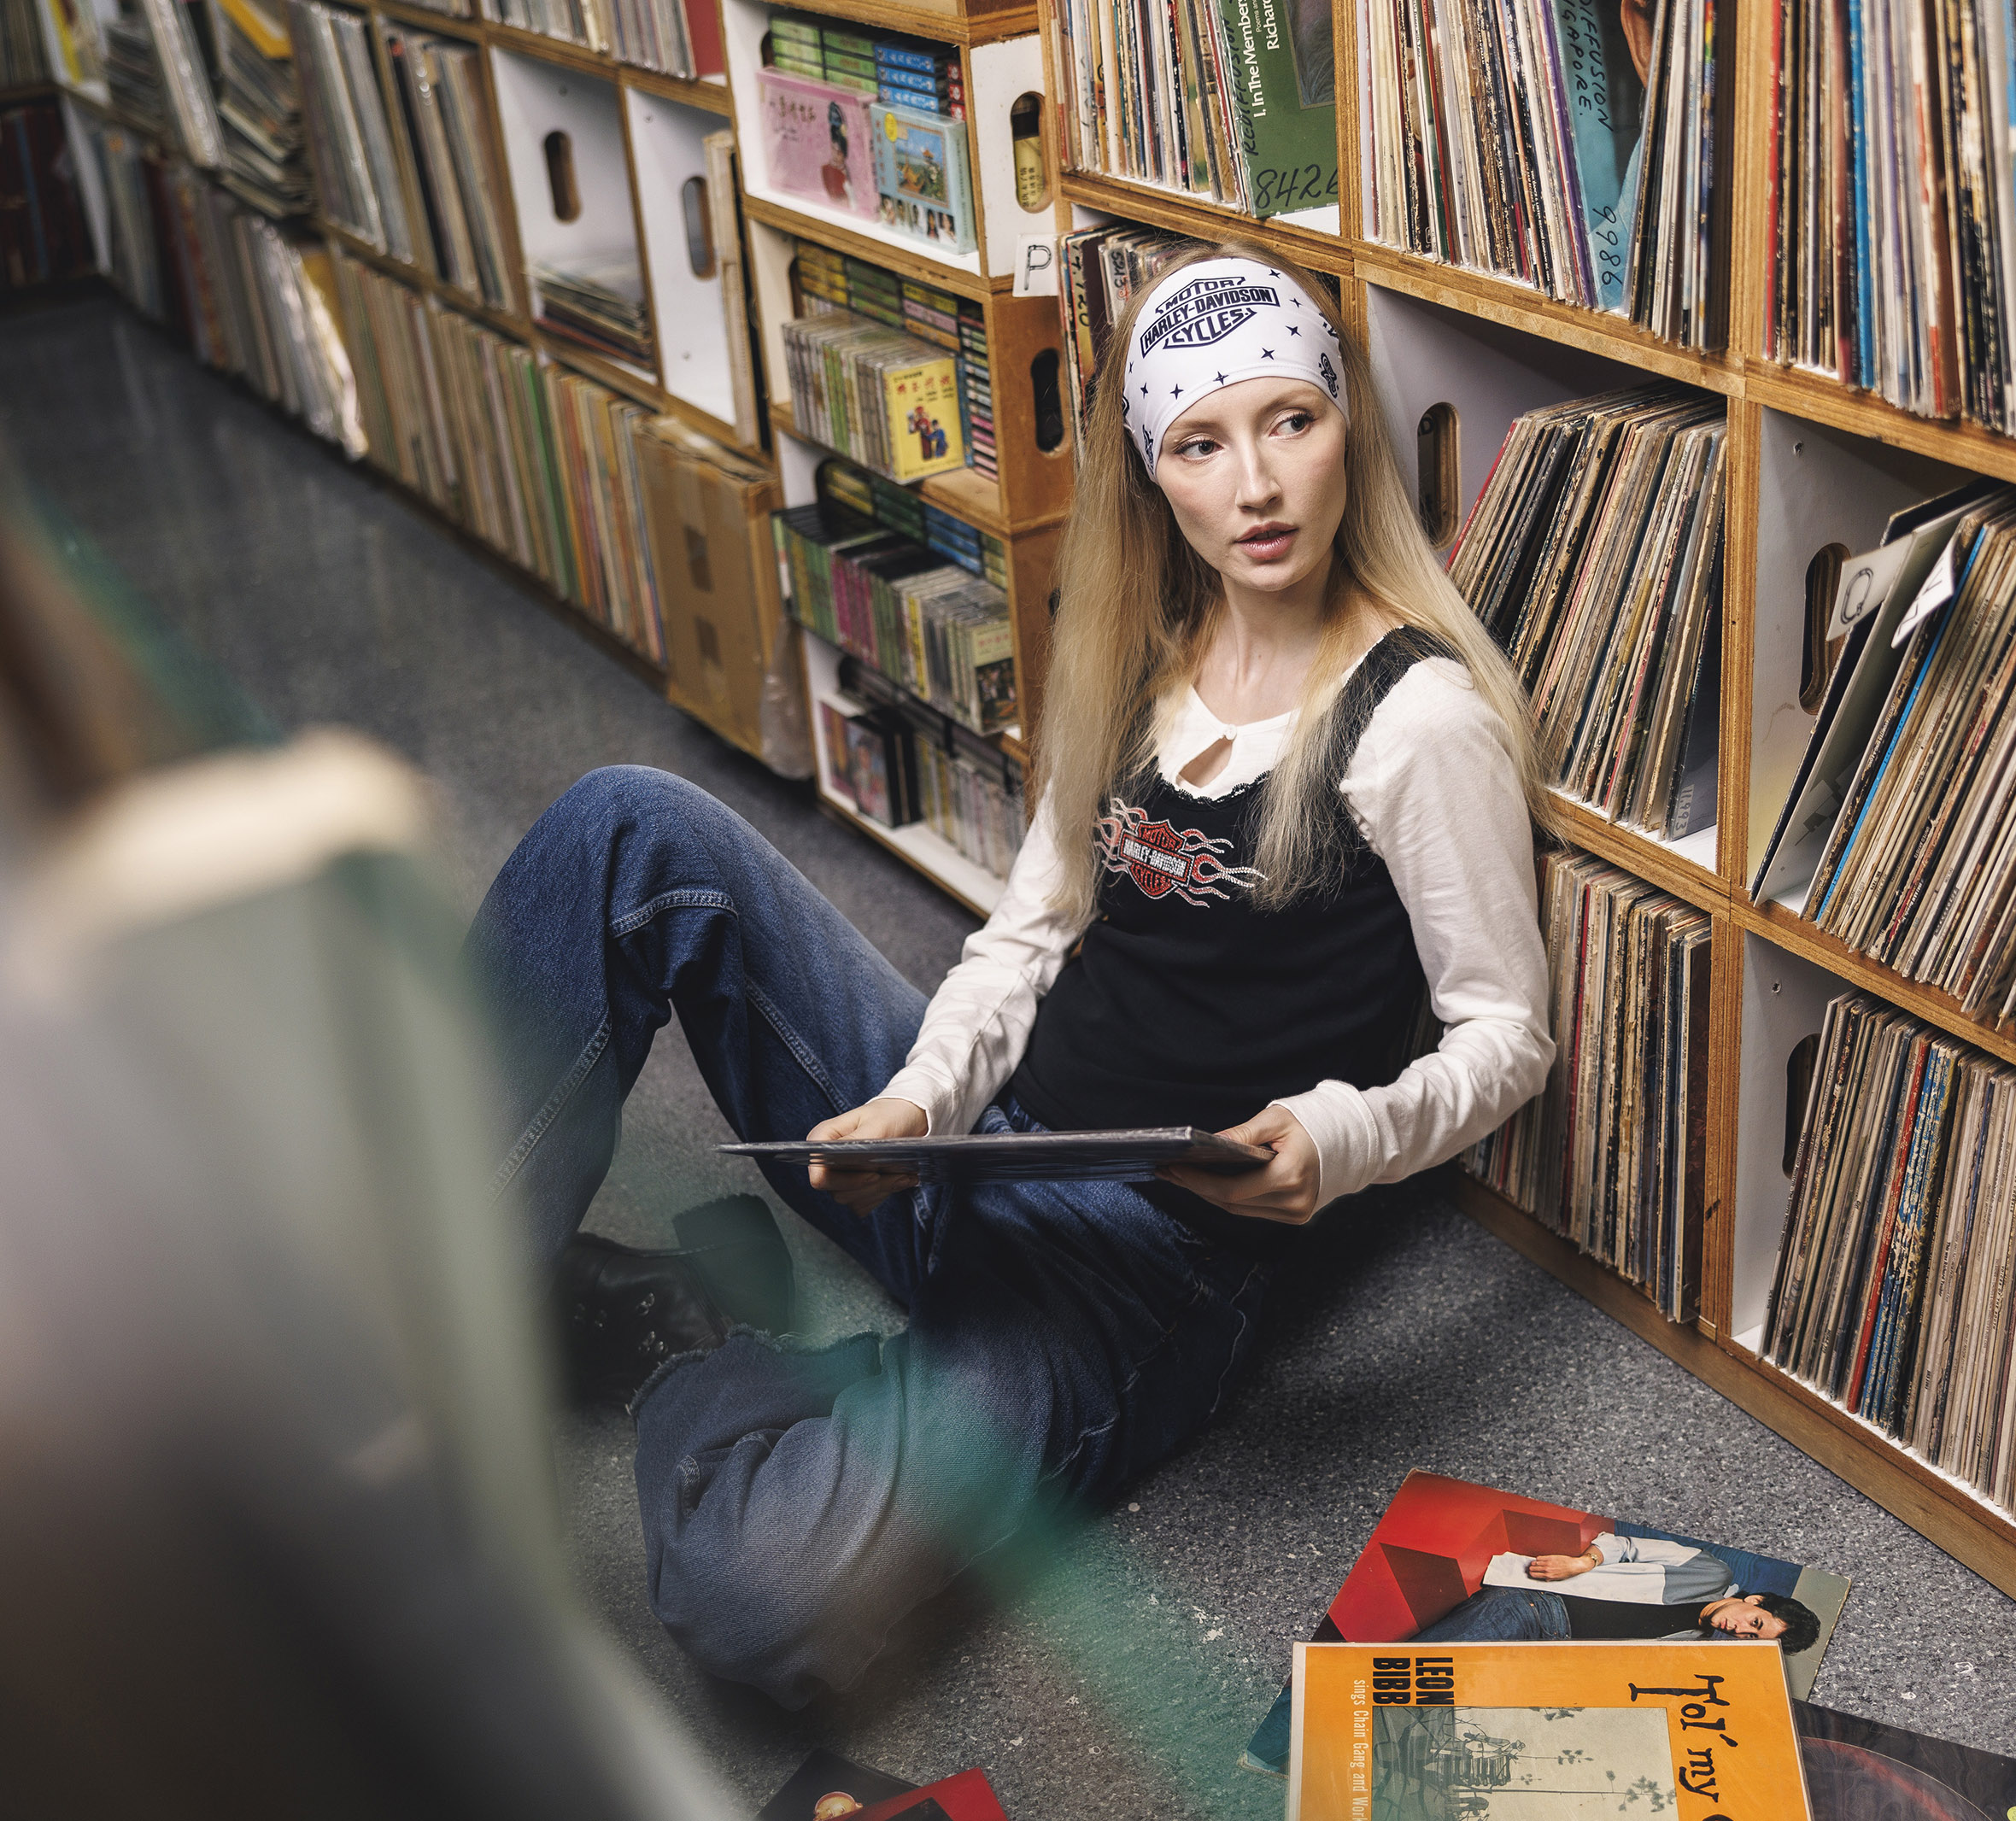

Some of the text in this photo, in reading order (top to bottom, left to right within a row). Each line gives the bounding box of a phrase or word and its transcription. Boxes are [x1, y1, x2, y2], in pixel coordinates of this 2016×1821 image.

[1411, 11, 1420, 27] Dance
[1248, 65, 1260, 89] The
[1253, 86, 1266, 106] In
[1592, 205, 1623, 285] 9986
[1023, 244, 1052, 291] P
[1164, 279, 1235, 311] MOTOR
[1143, 288, 1274, 350] HARLEY-DAVIDSON
[1141, 827, 1177, 852] MOTOR
[1912, 825, 1931, 858] UNITED ARTISTS
[1122, 837, 1188, 878] HARLEY-DAVIDSON
[1134, 864, 1172, 890] CYCLES
[1793, 1139, 1805, 1166] Spectacular
[1789, 1166, 1799, 1186] Minstrels
[1784, 1198, 1792, 1214] George
[1779, 1214, 1789, 1232] Mitchell
[1775, 1231, 1785, 1251] Minstrels
[1939, 1261, 1949, 1279] Richard
[1996, 1265, 2007, 1285] VOICES
[1937, 1279, 1945, 1297] Tauber
[1990, 1310, 1999, 1330] SOUTH
[1350, 1679, 1369, 1706] sings
[1372, 1657, 1411, 1704] BIBB
[1415, 1657, 1455, 1705] LEON
[1353, 1710, 1369, 1738] Chain
[1350, 1742, 1369, 1768] Gang
[1352, 1772, 1368, 1792] and
[1679, 1748, 1720, 1804] my
